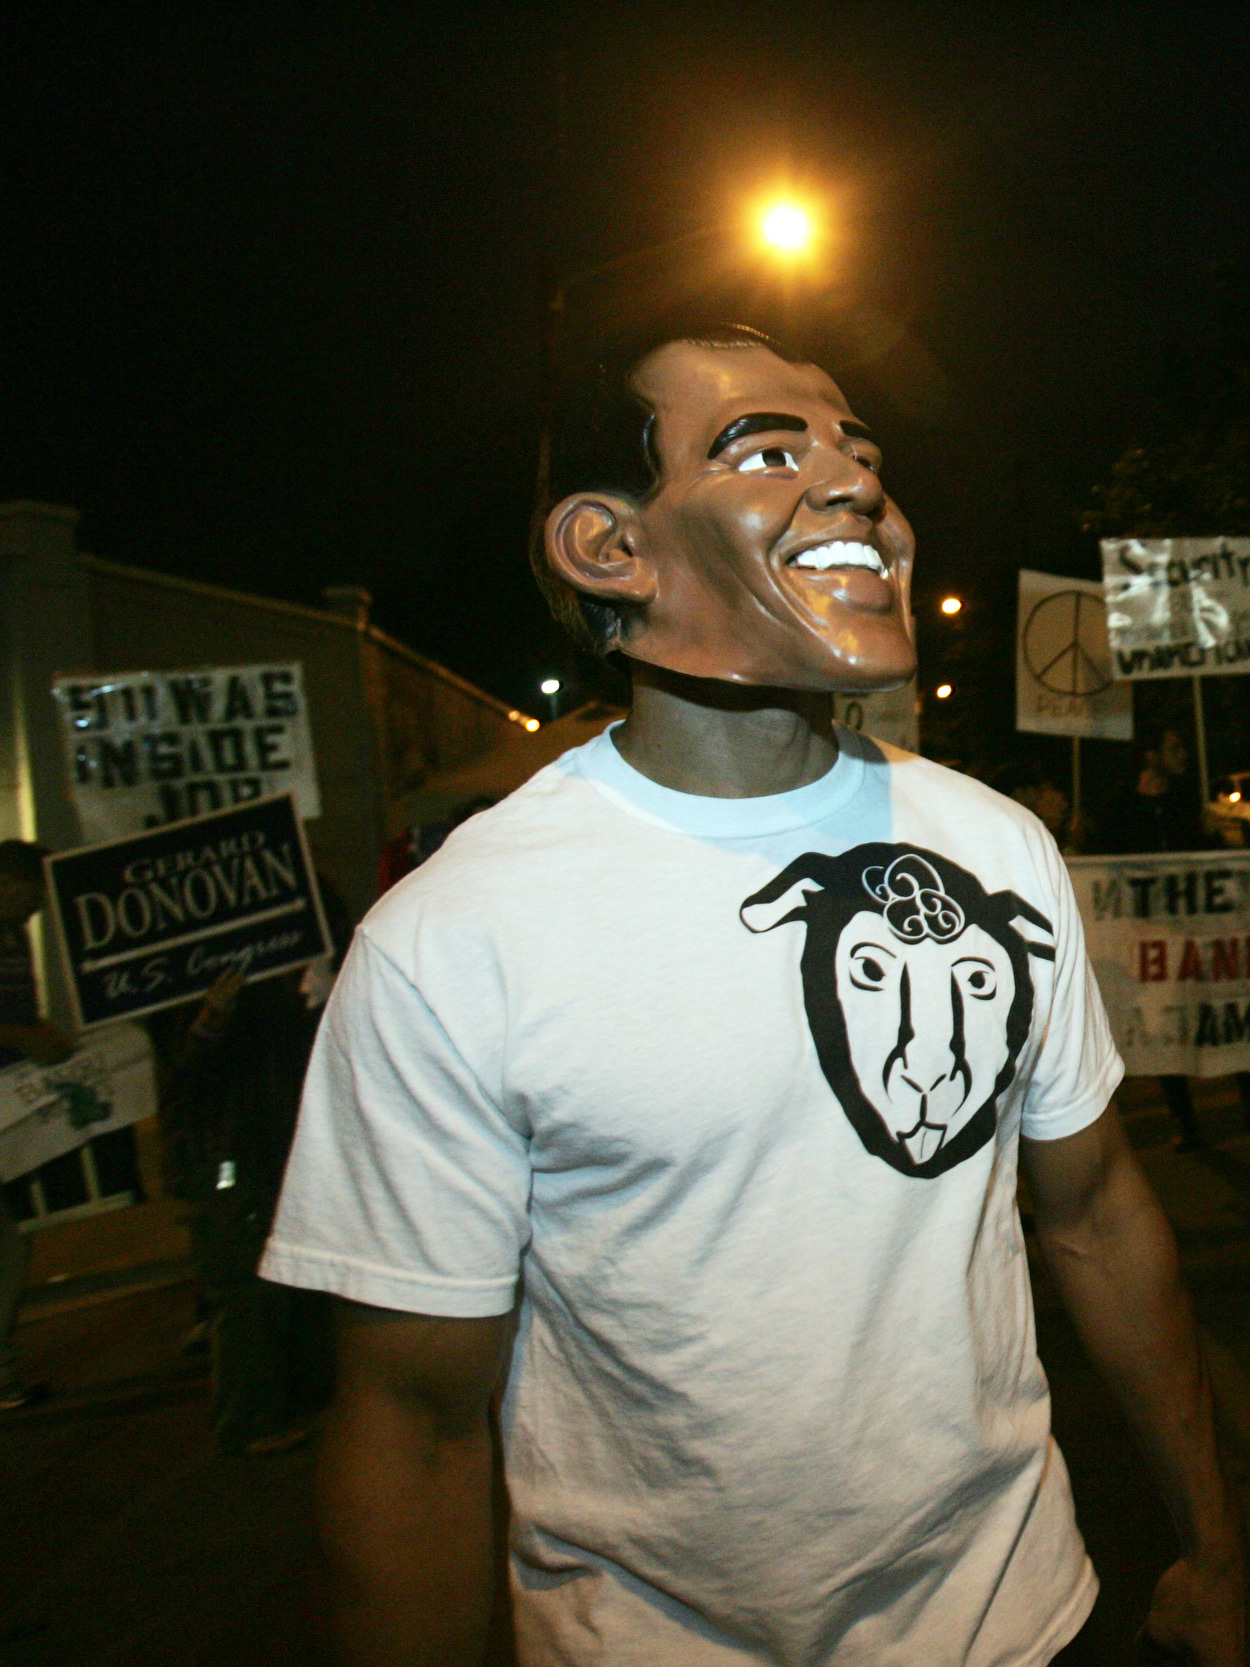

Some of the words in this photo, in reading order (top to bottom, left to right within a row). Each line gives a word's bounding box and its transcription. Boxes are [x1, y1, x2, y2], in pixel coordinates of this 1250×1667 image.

[168, 671, 299, 723] WAS
[123, 829, 266, 884] GERARD
[74, 842, 297, 950] DONOVAN
[1129, 868, 1233, 917] THE
